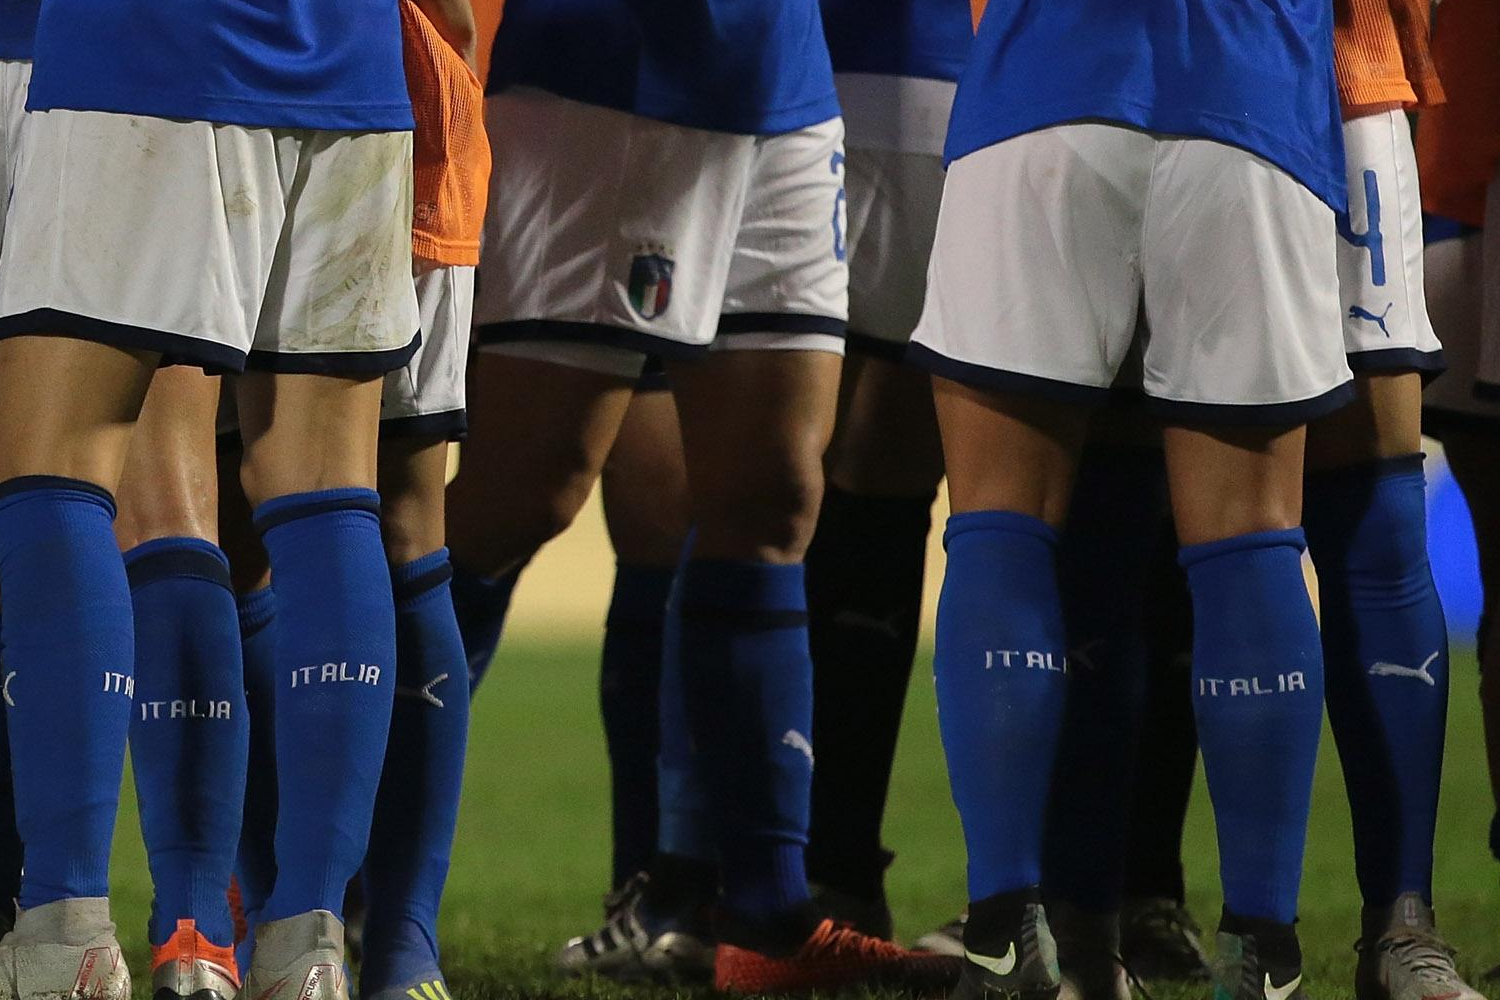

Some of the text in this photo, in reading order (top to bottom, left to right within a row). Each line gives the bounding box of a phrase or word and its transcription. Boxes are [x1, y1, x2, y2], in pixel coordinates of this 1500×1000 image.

[291, 662, 380, 688] ITALIA
[1200, 671, 1306, 696] ITALIA
[141, 700, 231, 721] ITALIA
